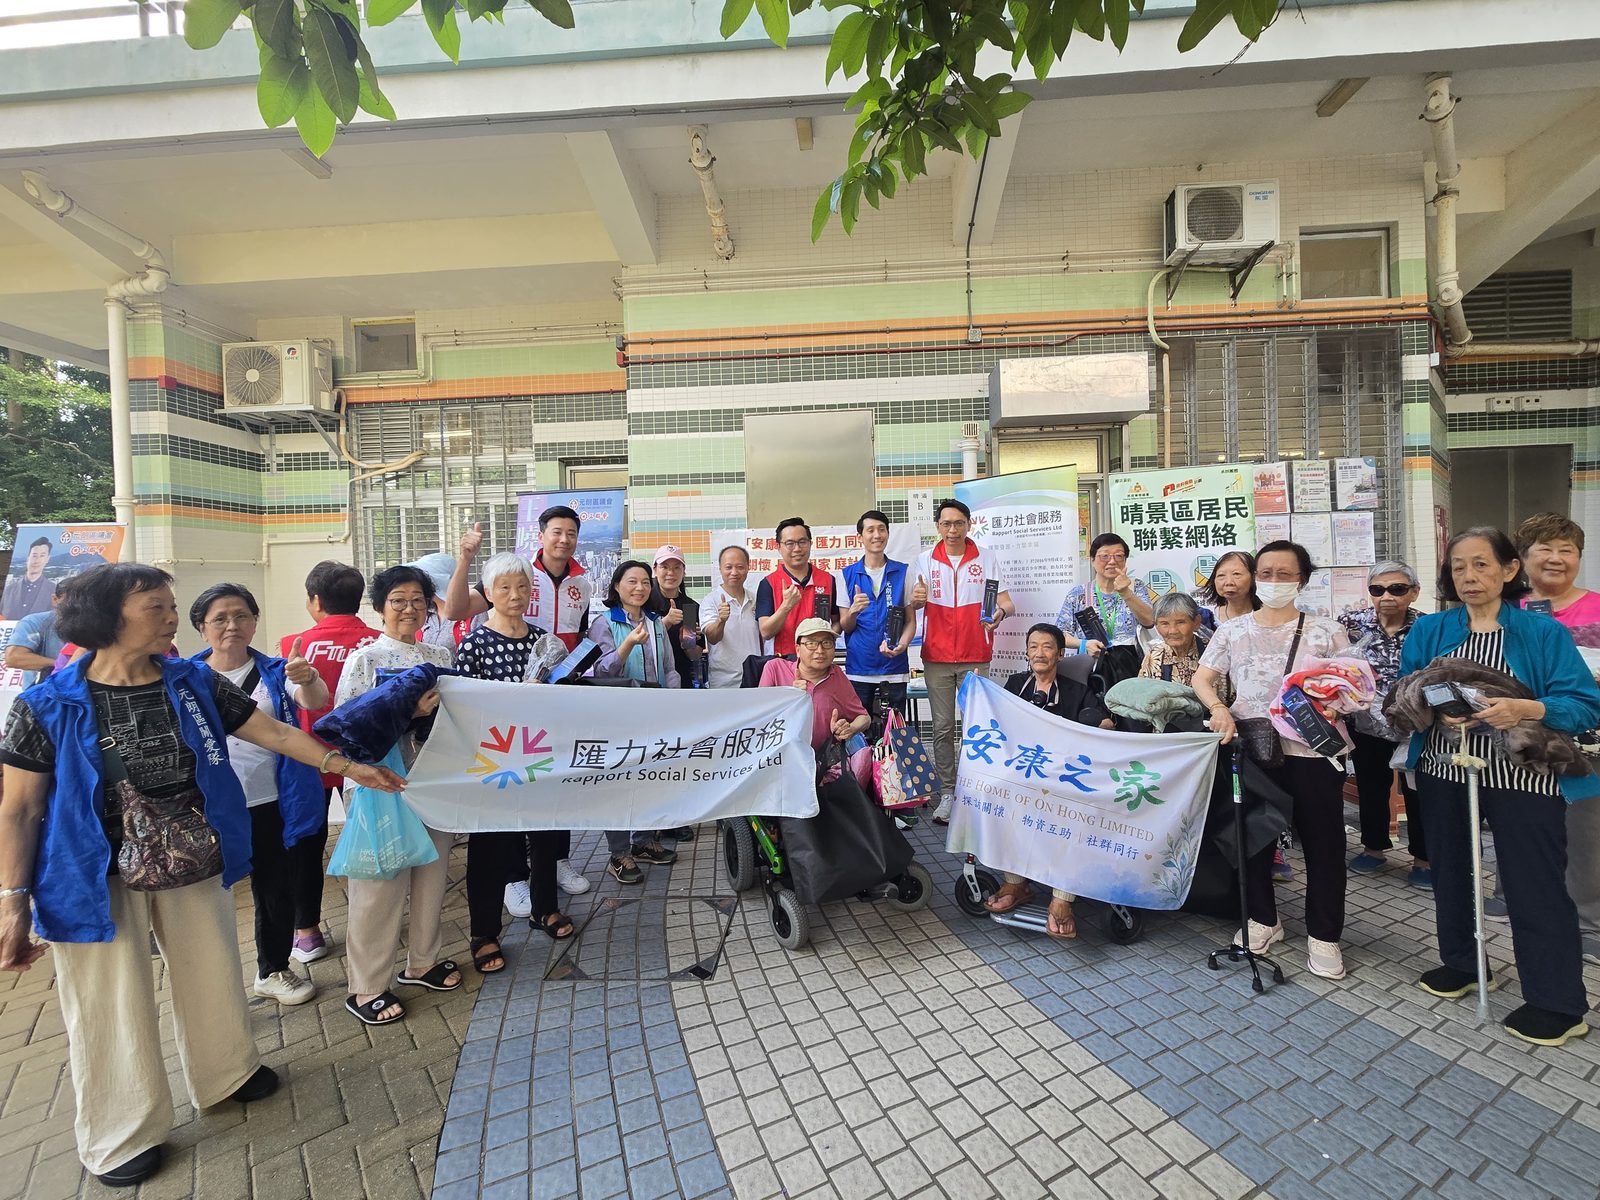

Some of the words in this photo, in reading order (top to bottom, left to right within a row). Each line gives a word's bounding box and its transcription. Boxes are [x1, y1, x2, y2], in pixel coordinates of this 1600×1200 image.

[917, 502, 924, 510] B
[992, 510, 1062, 529] 匯力社會服務
[1120, 496, 1249, 526] 晴景區居民
[1132, 522, 1238, 552] 聯繫網絡
[178, 688, 224, 767] 元朗區關愛隊
[569, 718, 786, 770] 匯力社會服務
[637, 767, 686, 781] Social
[692, 764, 753, 781] Services
[758, 752, 783, 770] Ltd
[962, 718, 1166, 811] 安康之家
[975, 779, 1011, 800] HOME
[1015, 793, 1032, 806] OF
[1034, 797, 1055, 813] ON
[1057, 804, 1096, 826] HONG
[1100, 816, 1154, 842] LIMITED
[1021, 814, 1072, 840] 物資互助
[1086, 834, 1140, 861] 社群同行
